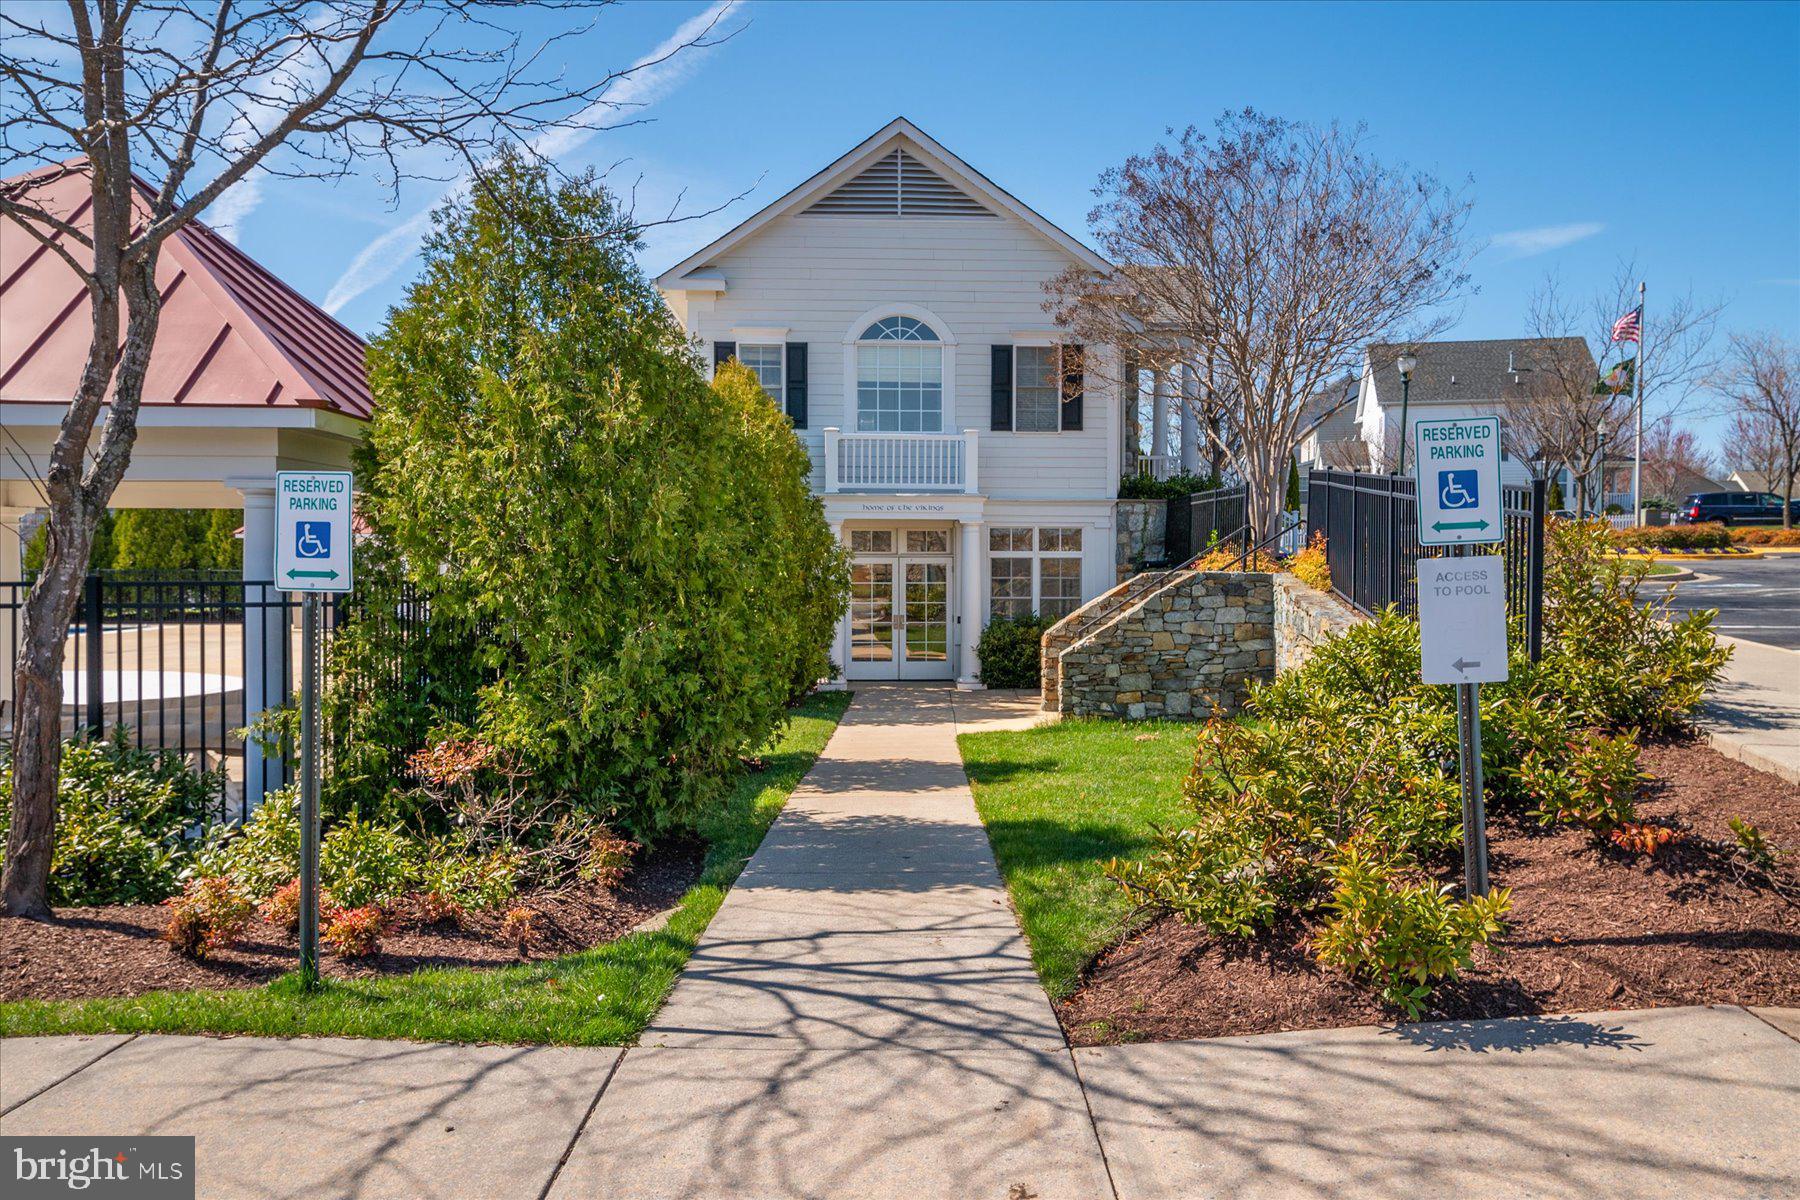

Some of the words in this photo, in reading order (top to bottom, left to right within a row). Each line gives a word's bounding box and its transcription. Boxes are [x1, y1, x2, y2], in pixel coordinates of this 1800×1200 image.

[1423, 425, 1491, 441] RESERVED
[1430, 444, 1485, 459] PARKING
[283, 480, 344, 493] RESERVED
[289, 497, 337, 511] PARKING
[1435, 570, 1488, 582] ACCESS
[1433, 586, 1451, 597] TO
[1455, 584, 1491, 596] POOL
